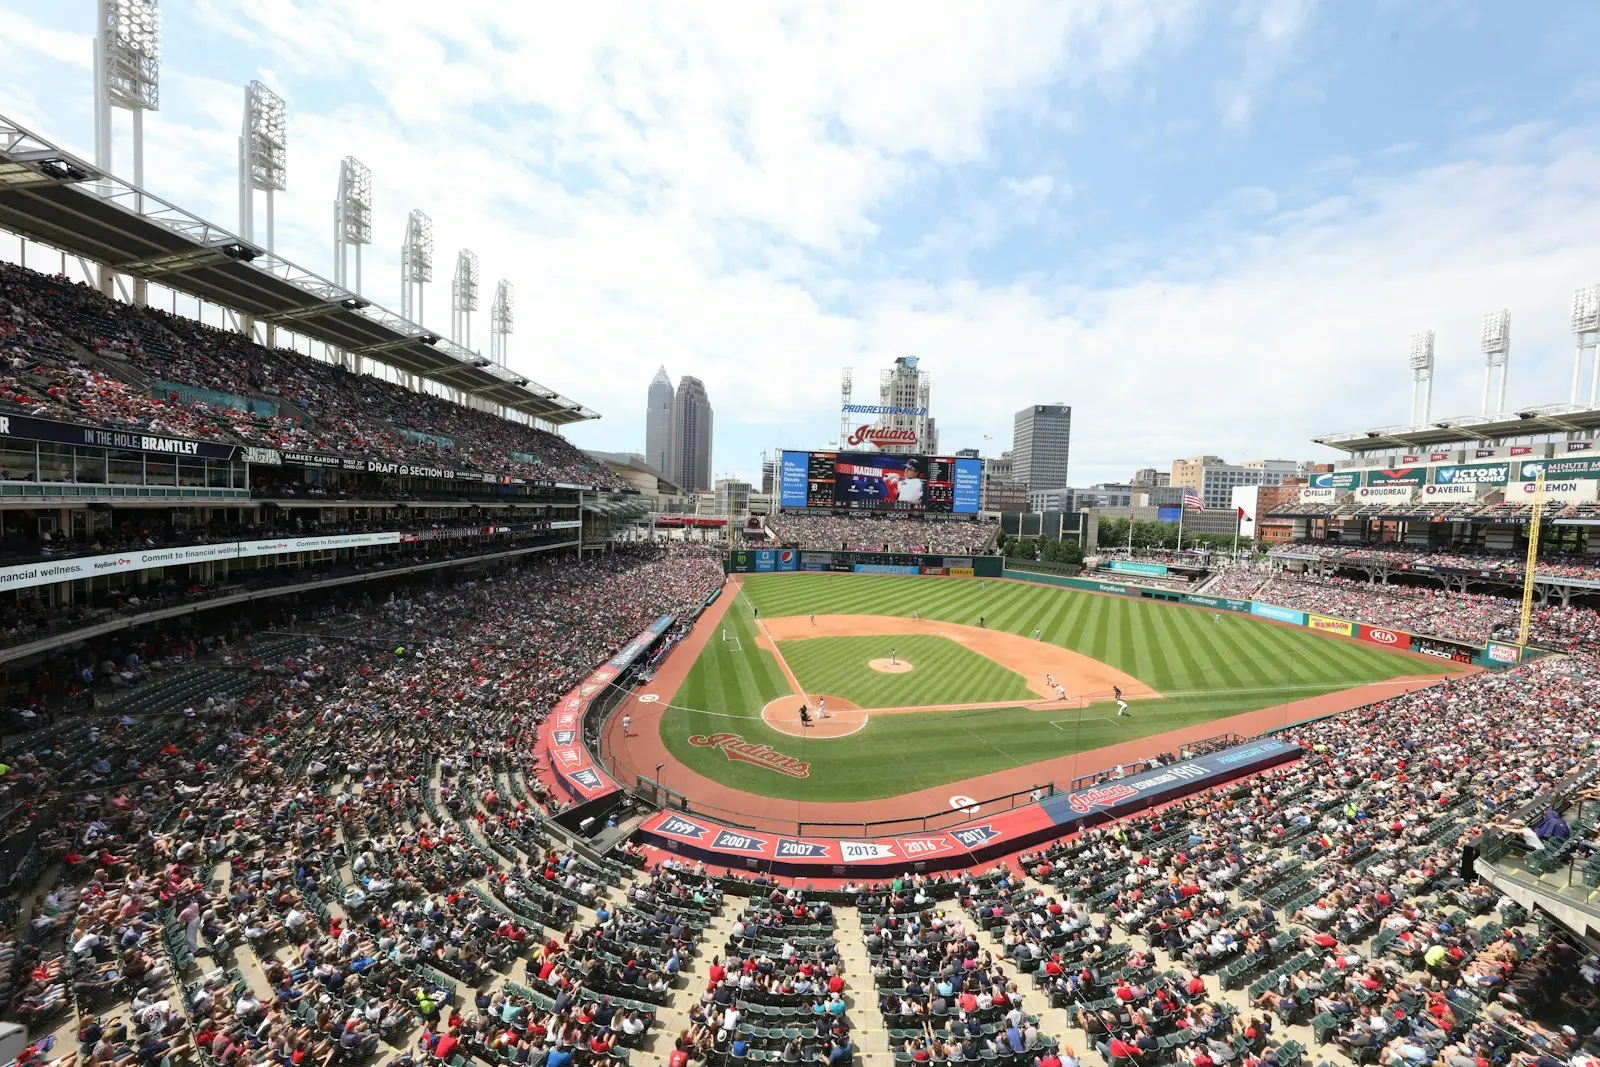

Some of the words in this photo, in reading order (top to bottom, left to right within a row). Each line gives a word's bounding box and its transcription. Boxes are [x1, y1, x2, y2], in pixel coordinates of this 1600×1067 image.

[841, 404, 901, 415] PROGRESSIVE
[901, 407, 927, 416] FIELD
[84, 429, 94, 443] IN
[96, 430, 112, 445] THE
[114, 432, 140, 449] HOLE:
[141, 436, 199, 455] BRANTLEY
[848, 425, 918, 448] Indians
[285, 453, 313, 462] MARKET
[313, 456, 339, 464] GARDEN
[368, 461, 398, 474] DRAFT
[400, 465, 409, 475] @
[409, 466, 442, 478] SECTION
[443, 470, 454, 479] 130
[853, 465, 882, 478] NAQUIN
[1548, 462, 1588, 471] MINUTE
[1439, 467, 1508, 481] VICTORY
[1370, 488, 1407, 496] BOUDREAU
[1437, 485, 1472, 494] AVERILL
[1542, 483, 1577, 492] EMON
[40, 565, 83, 577] wellness.
[94, 561, 117, 569] KeyBank
[141, 553, 173, 563] Commit
[175, 551, 183, 559] to
[185, 548, 216, 558] financial
[217, 546, 249, 555] wellness.
[1099, 584, 1126, 593] KeyBank
[1374, 630, 1393, 642] KIA
[1420, 647, 1452, 659] NOCO
[1492, 644, 1513, 656] drug
[1492, 652, 1515, 661] mart
[688, 733, 811, 779] Indians
[1069, 784, 1139, 813] Indians
[1166, 763, 1211, 780] 1901
[665, 820, 695, 834] 1999
[720, 835, 751, 848] 2001
[957, 828, 987, 844] 2017
[782, 843, 813, 855] 2007
[847, 845, 878, 856] 2013
[904, 840, 937, 853] 2016
